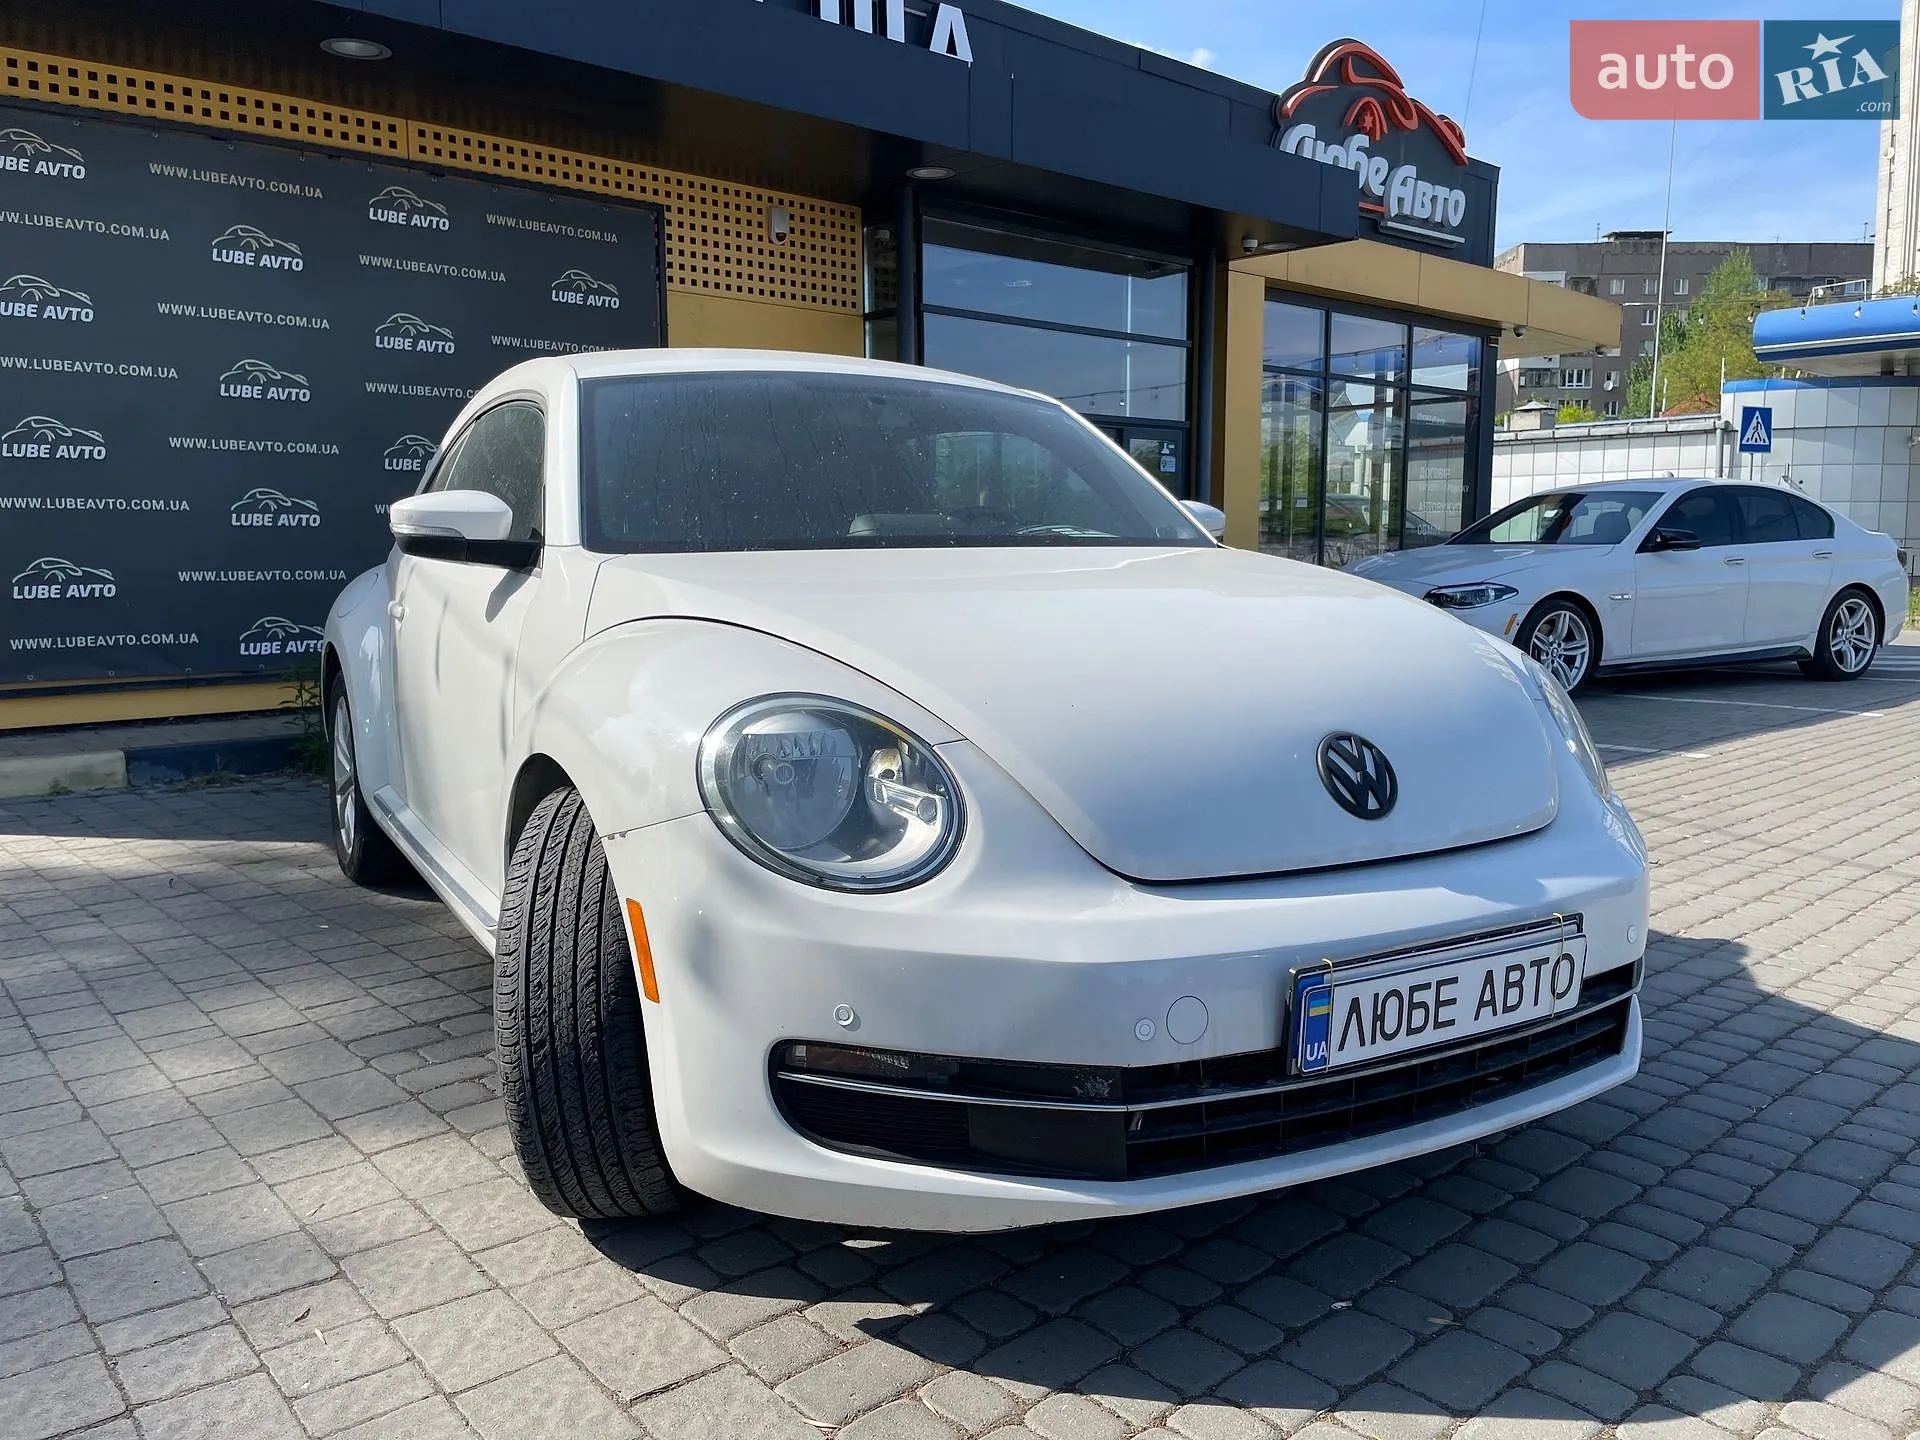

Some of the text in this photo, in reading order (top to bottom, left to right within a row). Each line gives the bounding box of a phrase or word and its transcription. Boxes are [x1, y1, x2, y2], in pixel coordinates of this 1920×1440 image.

[34, 157, 86, 179] AVTO
[149, 162, 323, 199] WWW.LUBEAVTO.COM.UA
[1386, 164, 1466, 227] Авто
[368, 206, 450, 231] LUBE AVTO
[486, 213, 618, 244] WWW.LUBEAVTO.COM.UA
[212, 247, 304, 272] LUBE AVTO
[359, 254, 506, 283] WWW.LUBEAVTO.COM.UA
[550, 288, 620, 309] LUBE AVTO
[42, 303, 94, 322] AVTO
[157, 302, 330, 330] WWW.LUBEAVTO.COM.UA
[374, 334, 455, 354] LUBE AVTO
[219, 383, 311, 402] LUBE AVTO
[1, 443, 106, 460] LUBE AVTO
[168, 436, 340, 455] WWW.LUBEAVTO.COM.UA
[384, 455, 422, 471] LUBE
[0, 497, 190, 511] WWW.LUBEAVTO.COM.UA
[231, 513, 321, 527] LUBE AVTO
[177, 570, 347, 582] WWW.LUBEAVTO.COM.UA
[12, 583, 116, 600] LUBE AVTO
[9, 632, 199, 650] WWW.LUBEAVTO.COM.UA
[240, 641, 282, 656] LUBE
[1338, 952, 1576, 1052] ЛЮБЕ АВТО
[1306, 1040, 1328, 1061] UA
